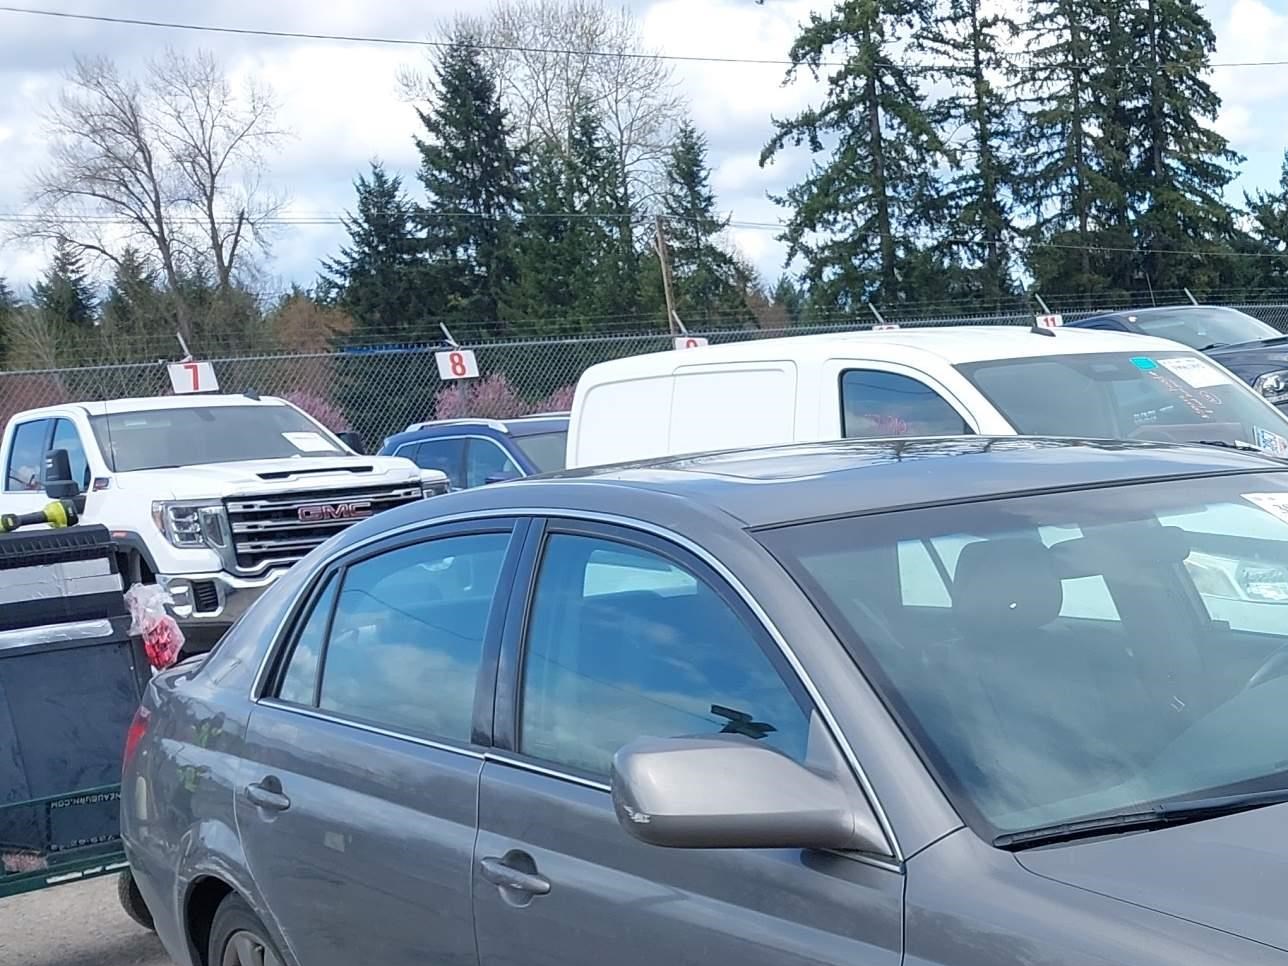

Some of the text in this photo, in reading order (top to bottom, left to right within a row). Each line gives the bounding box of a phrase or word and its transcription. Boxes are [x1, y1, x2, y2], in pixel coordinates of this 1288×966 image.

[449, 353, 466, 377] 8
[184, 364, 200, 391] 7
[298, 501, 374, 522] GMC
